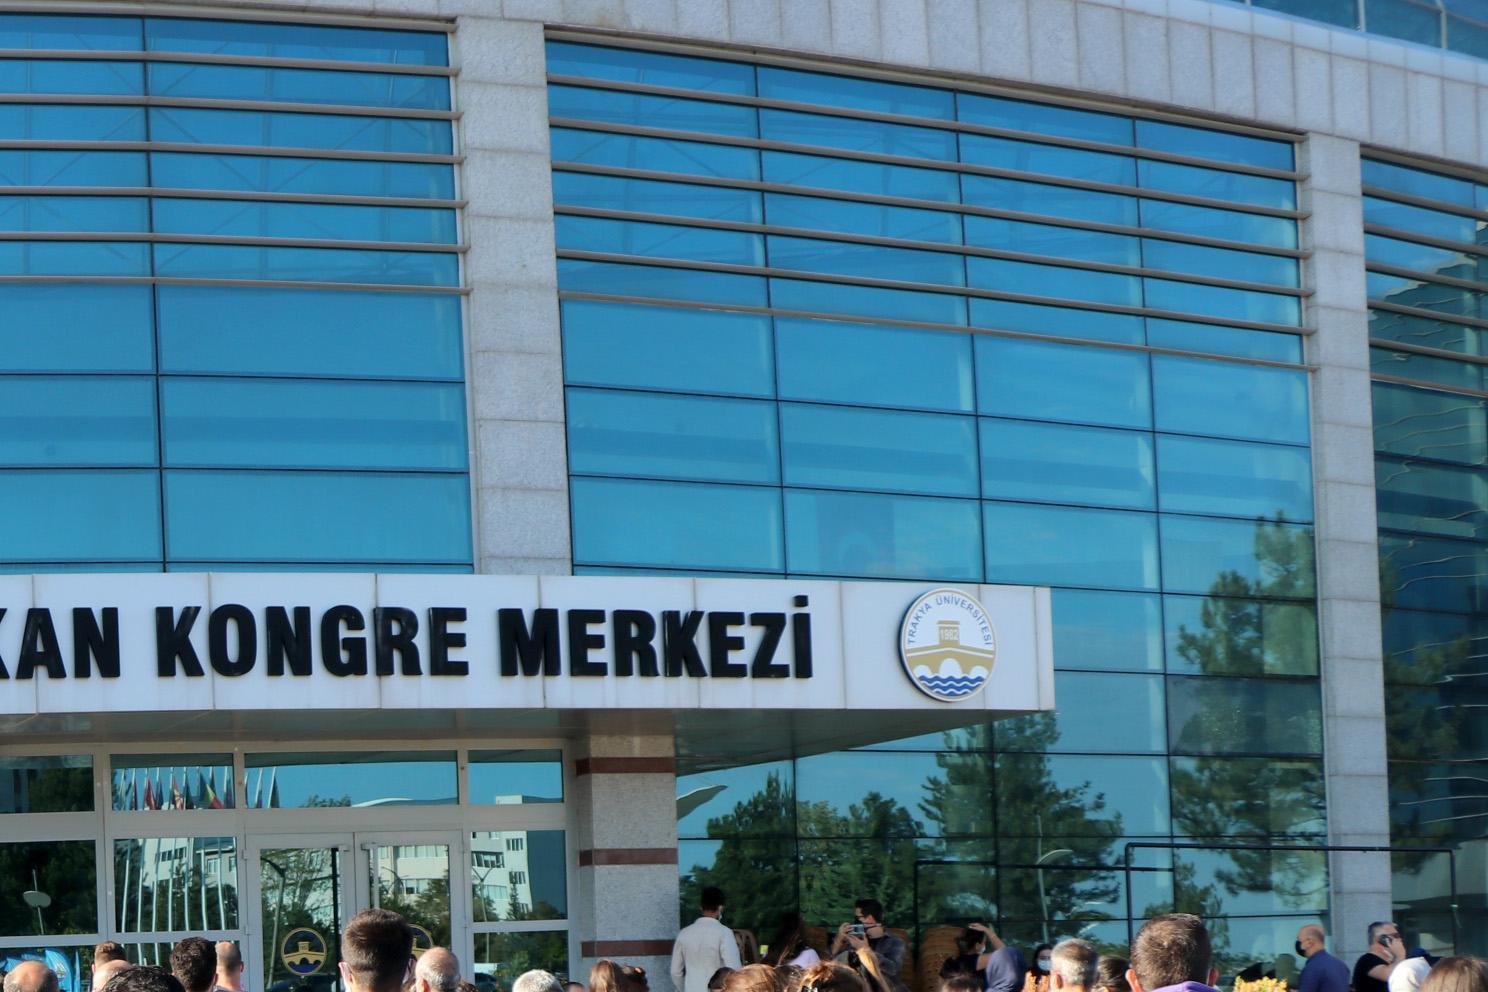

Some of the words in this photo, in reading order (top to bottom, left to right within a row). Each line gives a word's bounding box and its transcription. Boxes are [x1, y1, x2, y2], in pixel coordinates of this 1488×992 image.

[155, 604, 470, 678] KONGRE
[497, 595, 814, 679] MERKEZİ
[908, 602, 932, 644] TRAKYA
